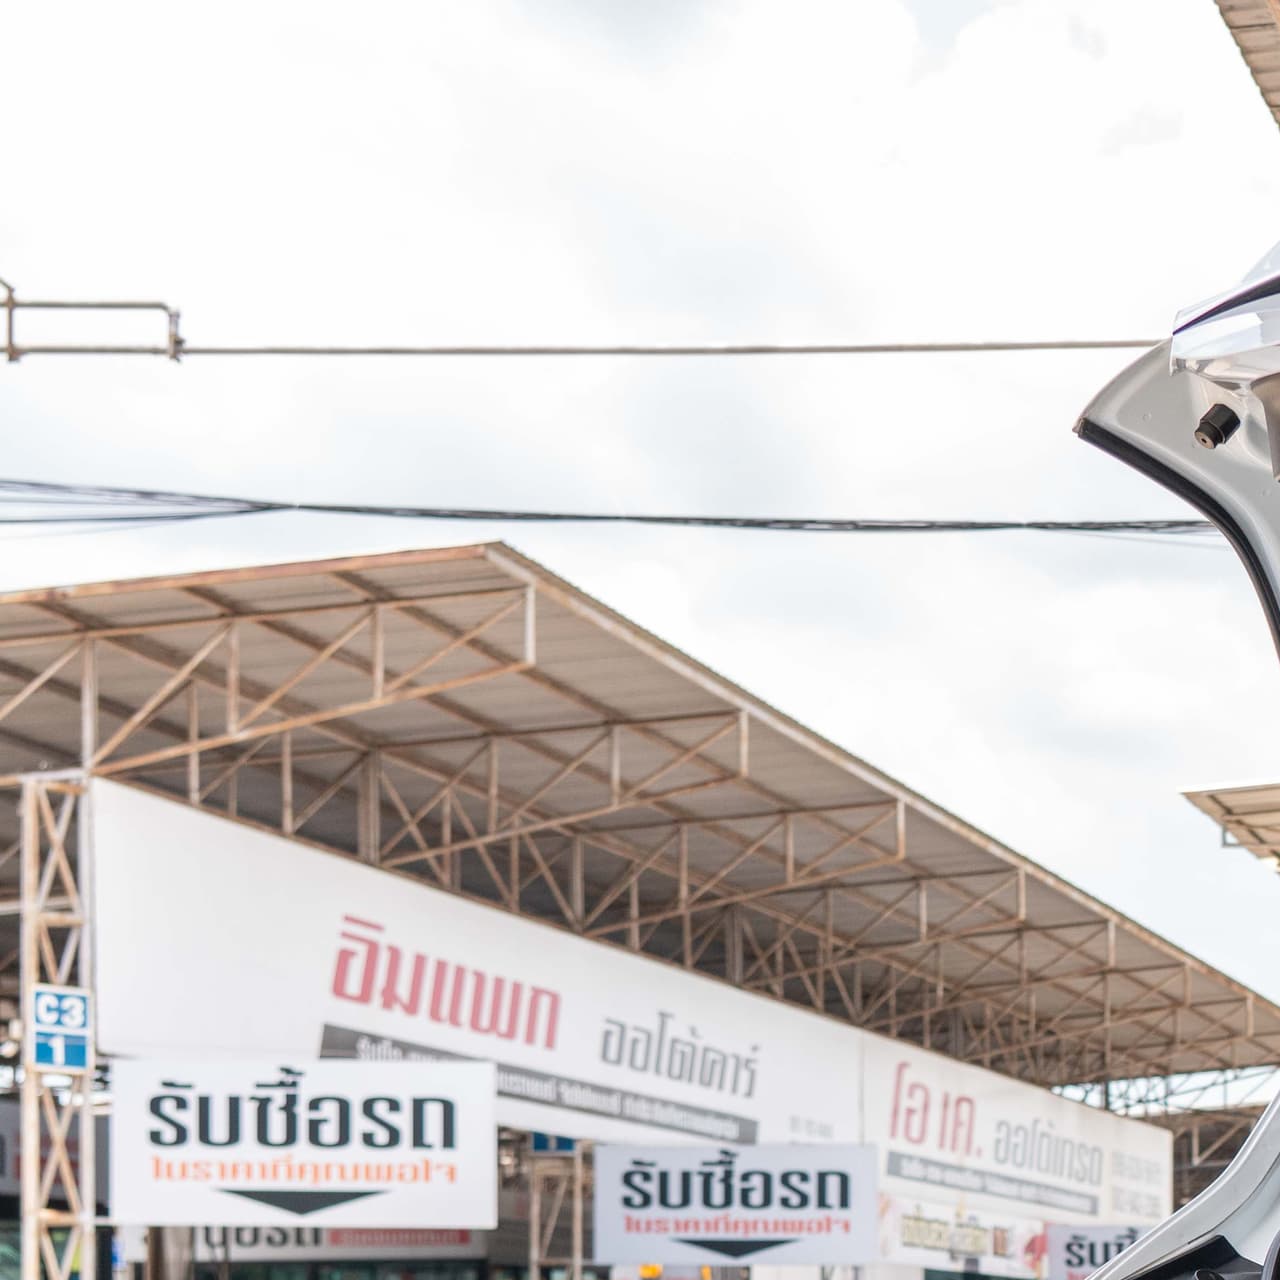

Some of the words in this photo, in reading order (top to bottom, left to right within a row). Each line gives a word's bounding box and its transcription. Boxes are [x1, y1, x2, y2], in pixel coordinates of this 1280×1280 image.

[37, 994, 85, 1028] C3
[48, 1034, 65, 1065] 1
[600, 1010, 760, 1098] ออโต้คาร์
[149, 1066, 456, 1149] รับซื้อรถ
[622, 1149, 851, 1210] รับซื้อรถ
